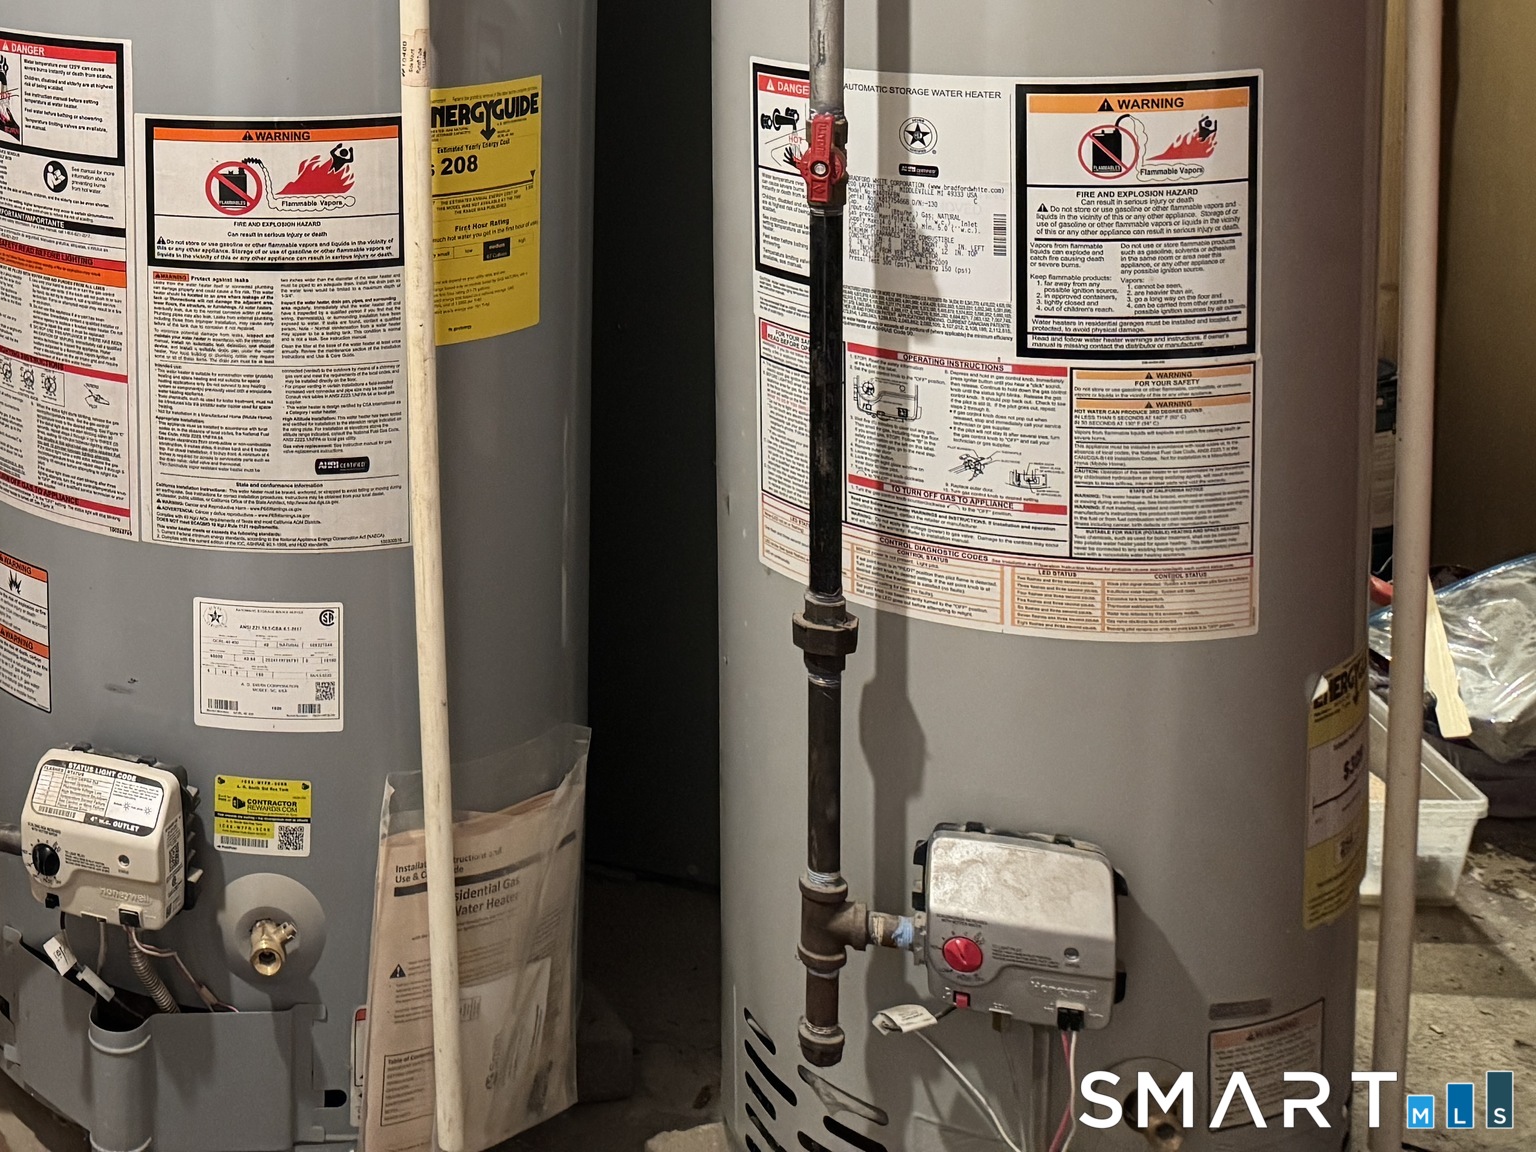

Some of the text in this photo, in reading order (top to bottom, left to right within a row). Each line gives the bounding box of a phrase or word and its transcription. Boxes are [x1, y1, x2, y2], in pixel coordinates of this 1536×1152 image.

[11, 43, 45, 56] DANGER
[777, 81, 809, 95] DANGE
[844, 83, 1001, 99] AUTOMATIC STORAGE WATER HEATER
[431, 92, 539, 128] NERGYGUIDE
[1118, 98, 1184, 109] WARNING
[256, 131, 310, 141] WARNING
[788, 136, 803, 144] HOT
[441, 155, 478, 175] 208
[1180, 167, 1203, 175] Vapors
[890, 179, 924, 188] CORPORATION
[1117, 190, 1164, 198] EXPLOSION
[455, 224, 470, 232] First
[768, 333, 800, 349] READ BEFORE
[775, 329, 800, 342] FOR YOUR
[903, 354, 1004, 371] OPERATING INSTRUCTIONS
[903, 487, 921, 497] TURN
[924, 491, 937, 500] OFF
[939, 493, 955, 502] GAS
[958, 495, 968, 503] TO
[971, 498, 1013, 510] APPLIANCE
[879, 536, 988, 563] CONTROL DIAGNOSTIC CODES
[4, 555, 31, 575] WARNING
[6, 632, 33, 650] WARNING
[68, 763, 137, 782] STATUS LIGHT CODE
[247, 798, 297, 807] CONTRACTOR
[247, 805, 297, 813] REWARDS.COM
[113, 821, 139, 832] OUTLET
[396, 861, 427, 873] Installat
[396, 873, 418, 883] Use &
[455, 876, 520, 901] sidential Gas
[486, 892, 518, 910] Heater
